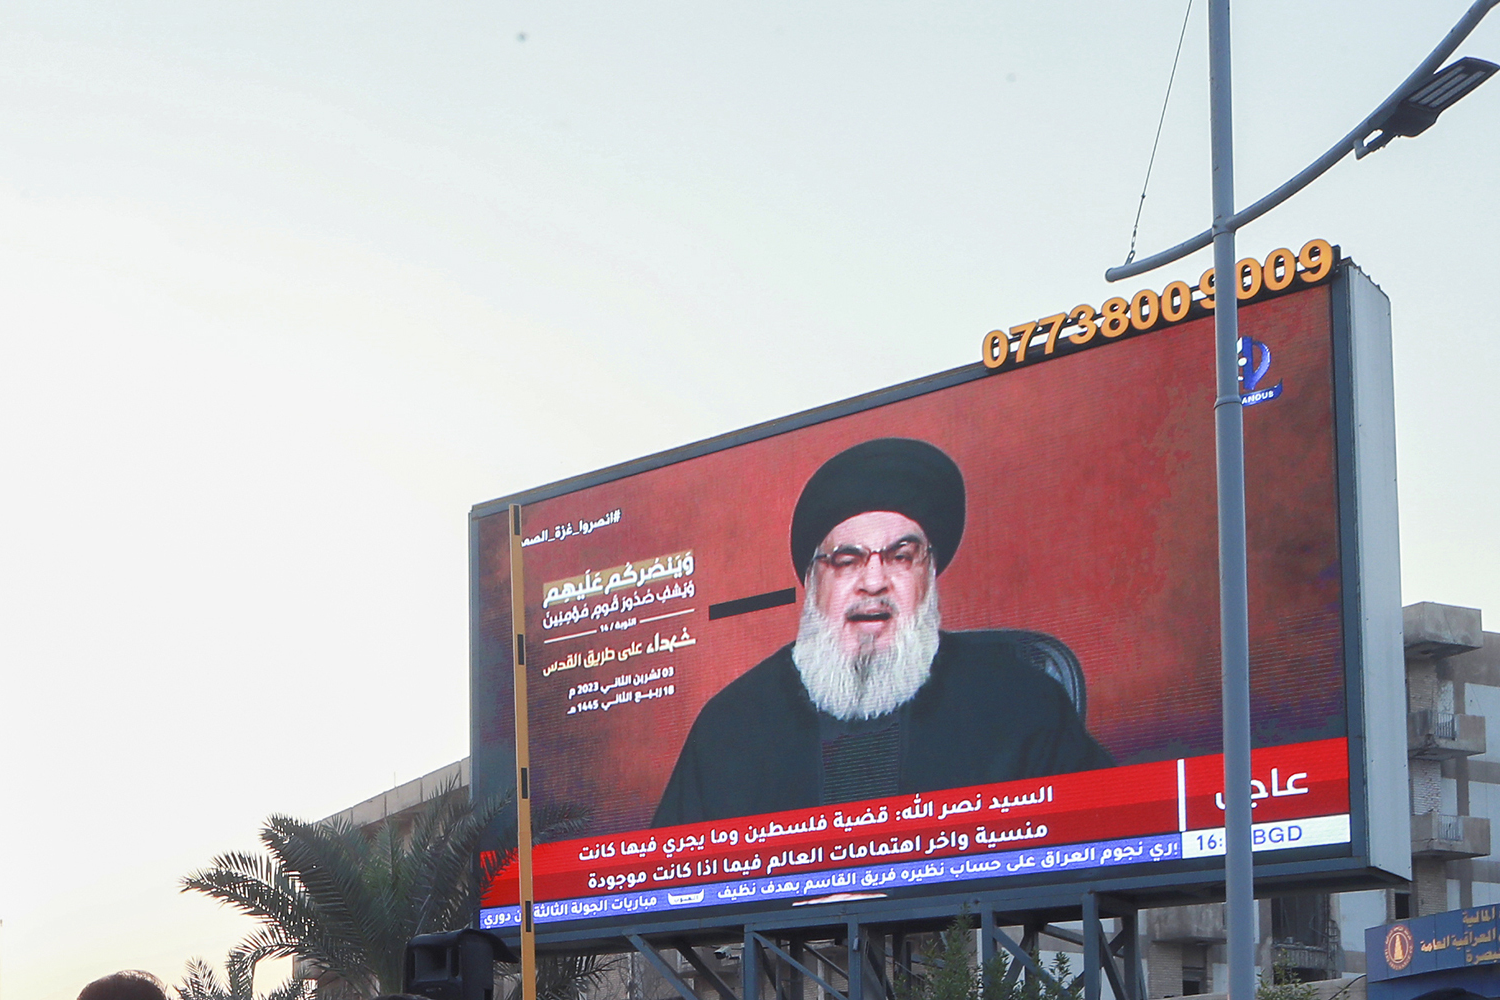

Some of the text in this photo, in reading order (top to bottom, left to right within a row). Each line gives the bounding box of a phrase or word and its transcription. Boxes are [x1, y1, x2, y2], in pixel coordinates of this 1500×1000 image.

[542, 627, 697, 676] شهداء على طريق القدس
[577, 681, 599, 695] 2023
[578, 785, 1053, 861] السيد نصر الله: قضية فلسطين وما يجري فيها كانت
[1253, 825, 1303, 845] BGD
[588, 820, 1048, 891] منسية واخر اهتمامات العالم فيما اذا كانت موجودة
[1041, 847, 1095, 868] العراق
[1100, 841, 1143, 864] نجوم
[901, 862, 945, 883] نظيره
[950, 858, 1001, 878] حساب
[1006, 854, 1036, 872] على
[804, 873, 856, 895] القاسم
[860, 868, 896, 887] فريق
[717, 882, 757, 900] نظيف
[760, 880, 800, 897] بهدف
[534, 903, 567, 918] الثالثة
[571, 900, 608, 915] الجولة
[611, 895, 657, 912] مباريات
[484, 912, 511, 929] دوري
[1420, 935, 1450, 952] العامة
